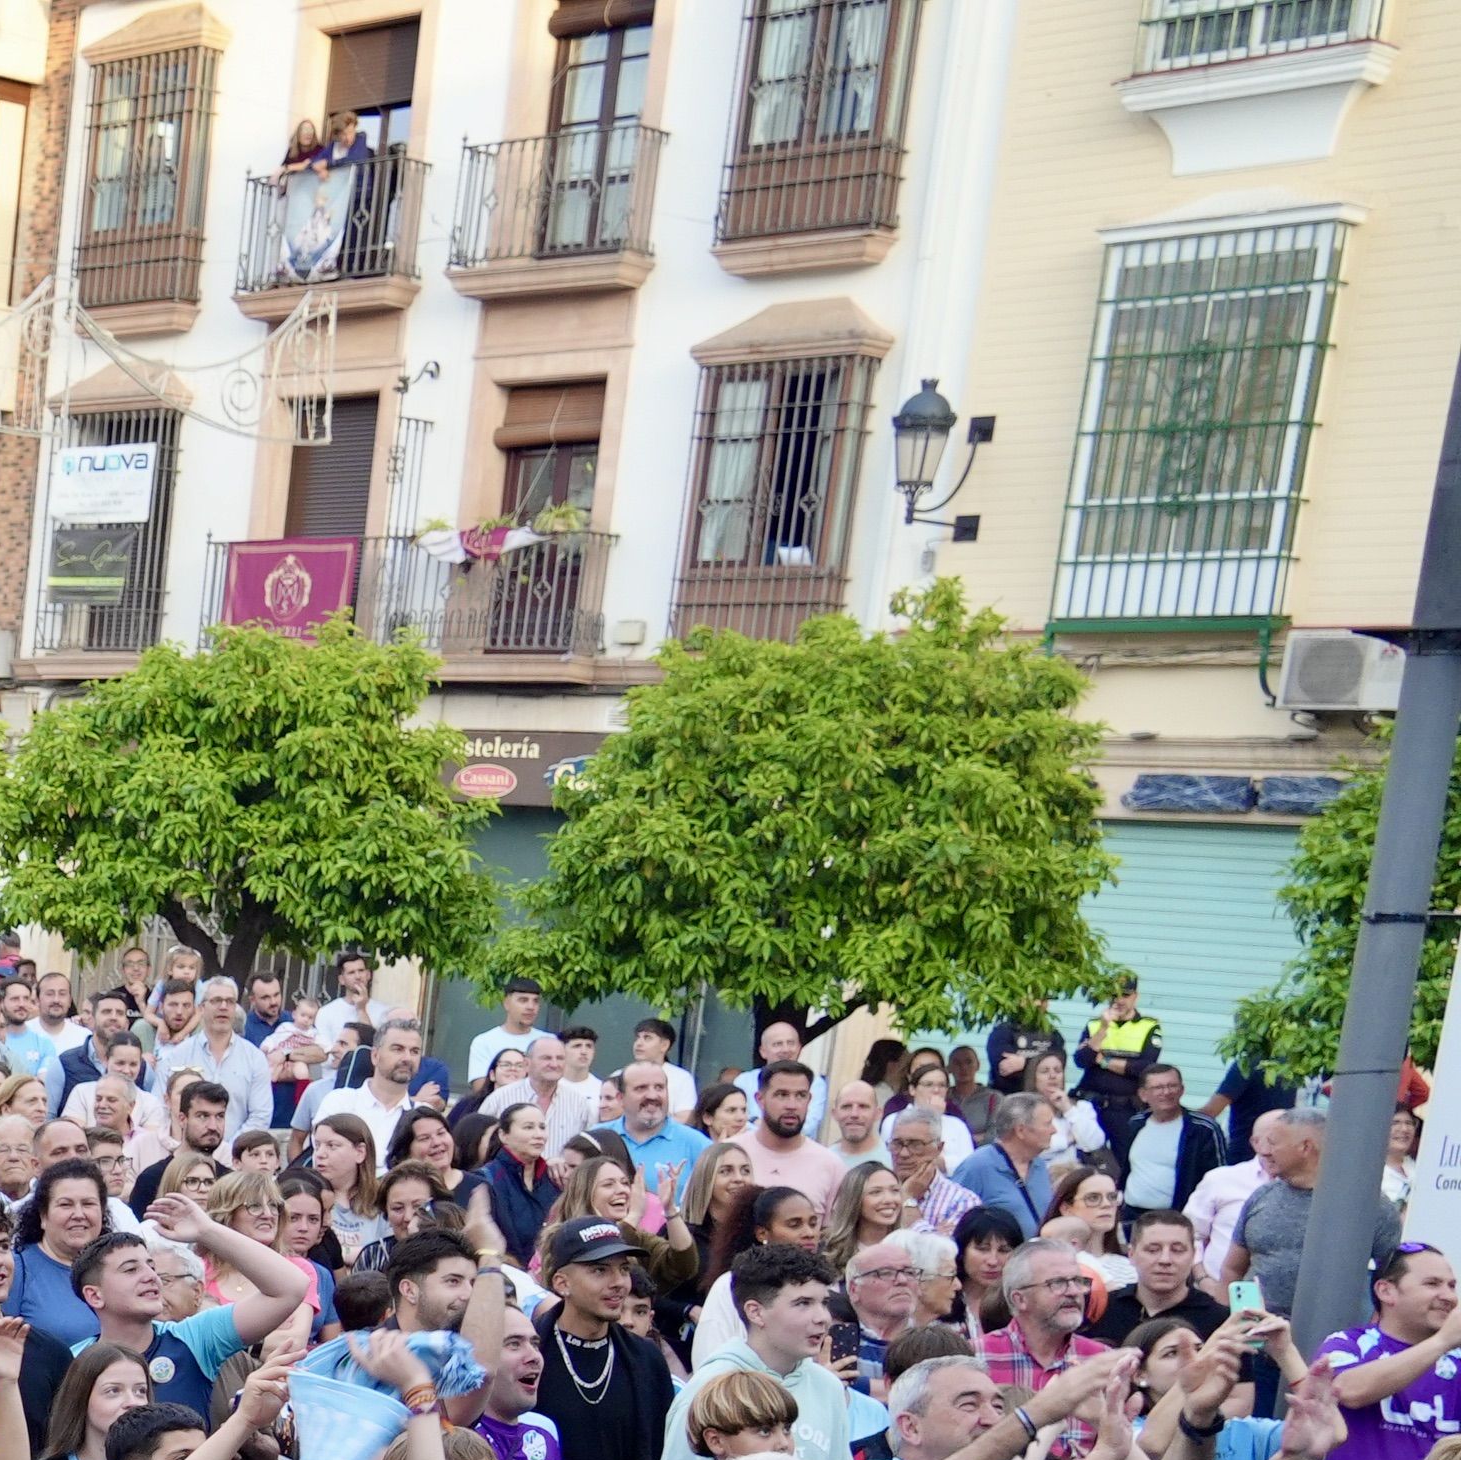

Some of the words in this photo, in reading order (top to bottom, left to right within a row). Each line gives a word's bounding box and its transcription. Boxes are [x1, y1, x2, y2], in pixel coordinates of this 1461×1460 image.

[78, 452, 148, 472] nuova
[464, 736, 540, 759] stelería
[1439, 1135, 1461, 1168] Lu
